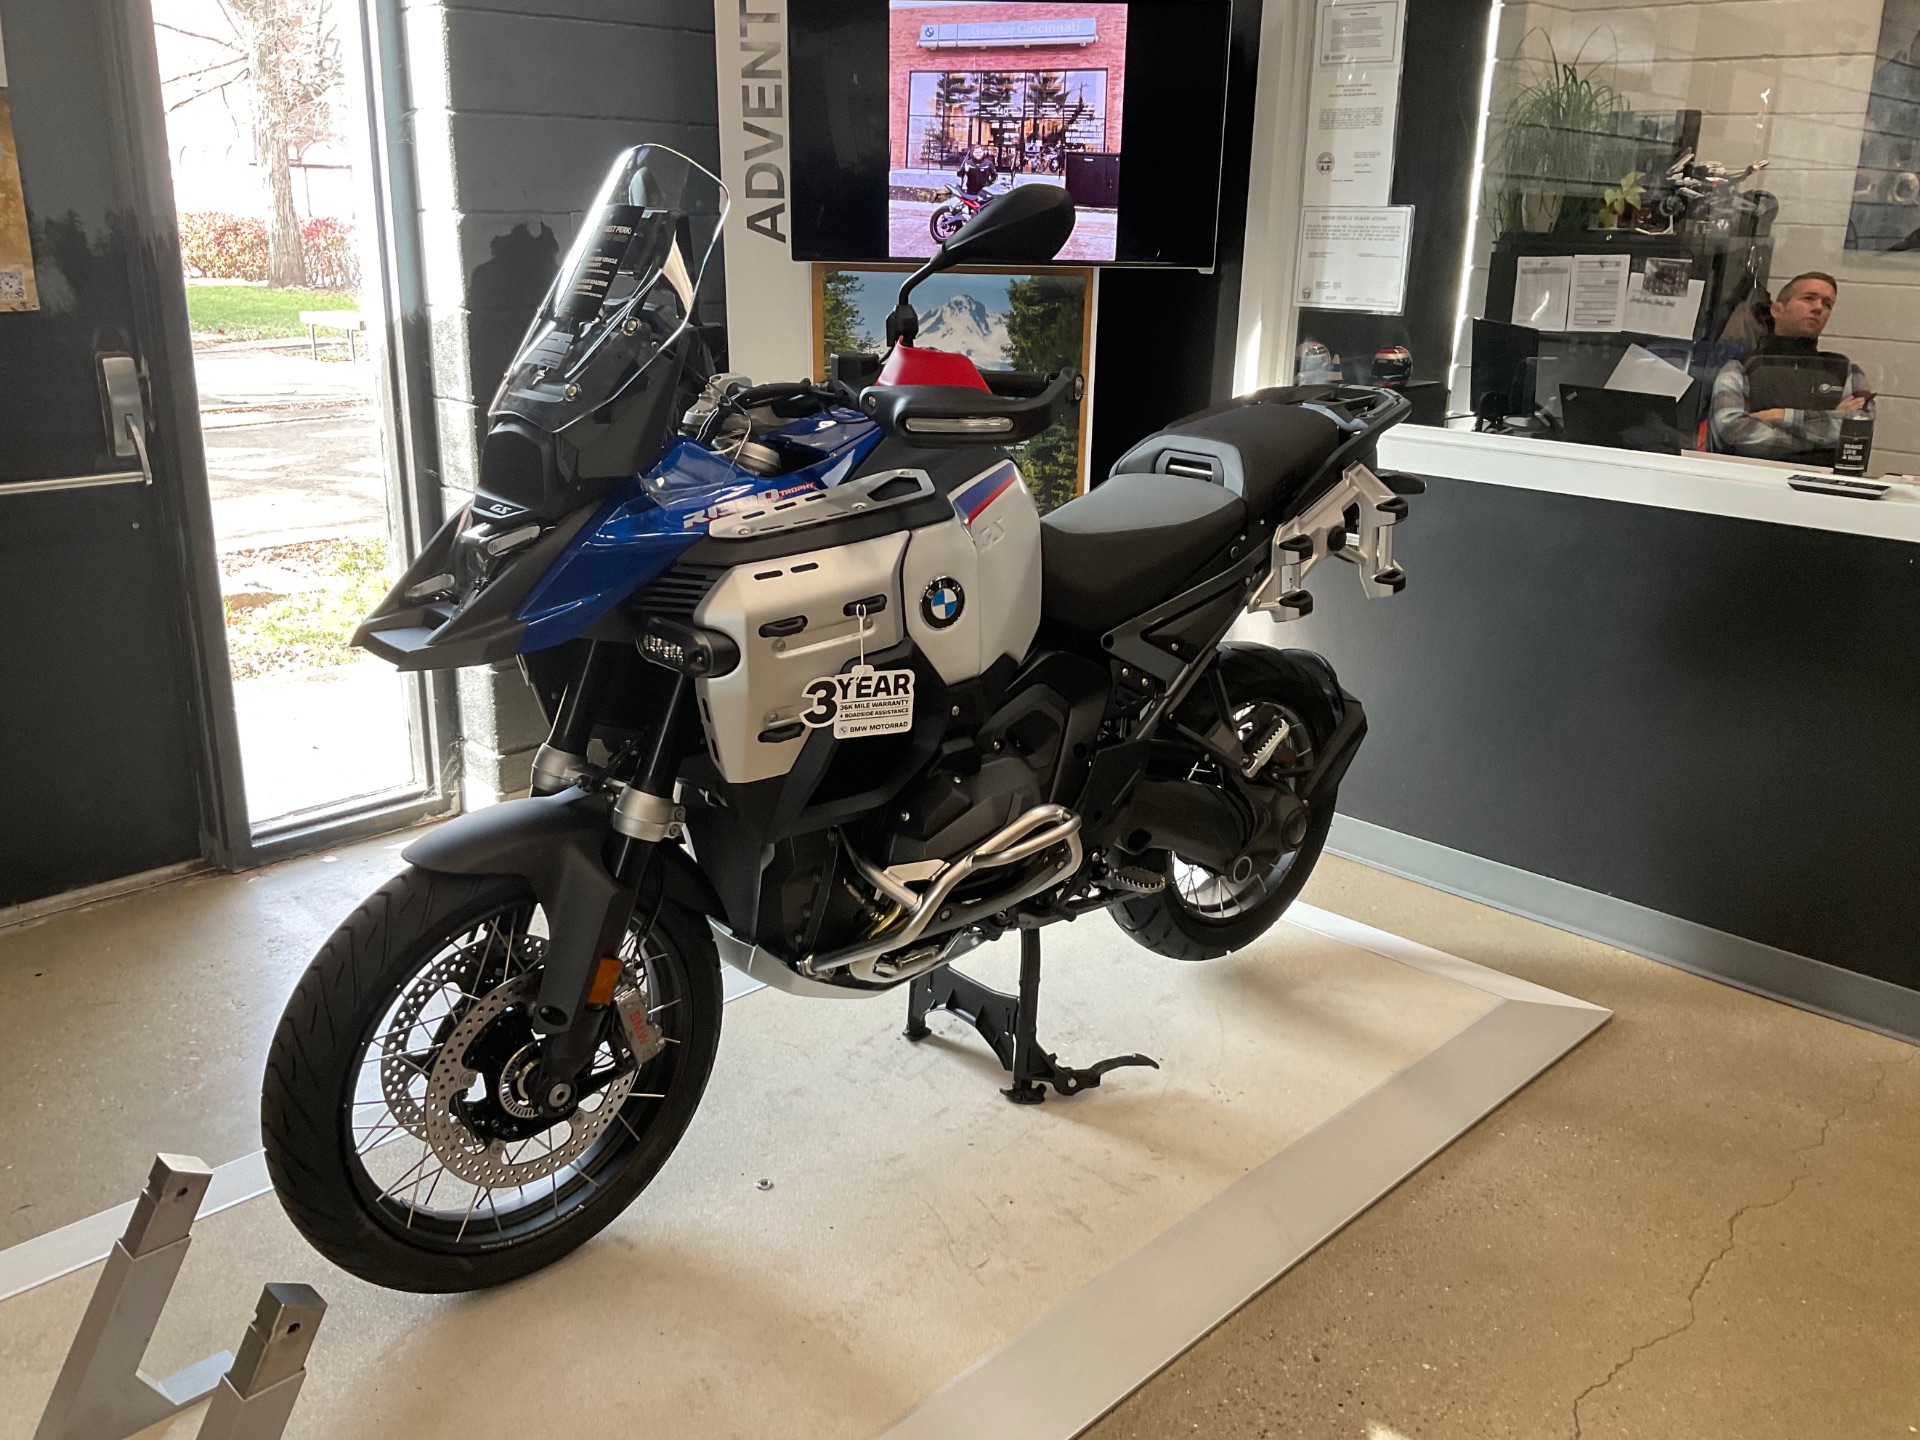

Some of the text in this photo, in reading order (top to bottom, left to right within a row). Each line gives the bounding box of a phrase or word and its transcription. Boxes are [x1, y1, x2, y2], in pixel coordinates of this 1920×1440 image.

[971, 20, 1080, 36] Greater Cincinnati
[739, 0, 787, 244] ADVENT
[779, 481, 816, 496] TROPHY
[489, 503, 513, 515] GS
[803, 673, 910, 725] 3 YEAR
[839, 699, 909, 711] 36K MILE WARRANTY
[844, 711, 874, 719] ROADSIDE
[874, 708, 909, 716] ASSISTANCE
[850, 721, 908, 733] BMW MOTORRAD
[629, 1009, 650, 1045] BMW
